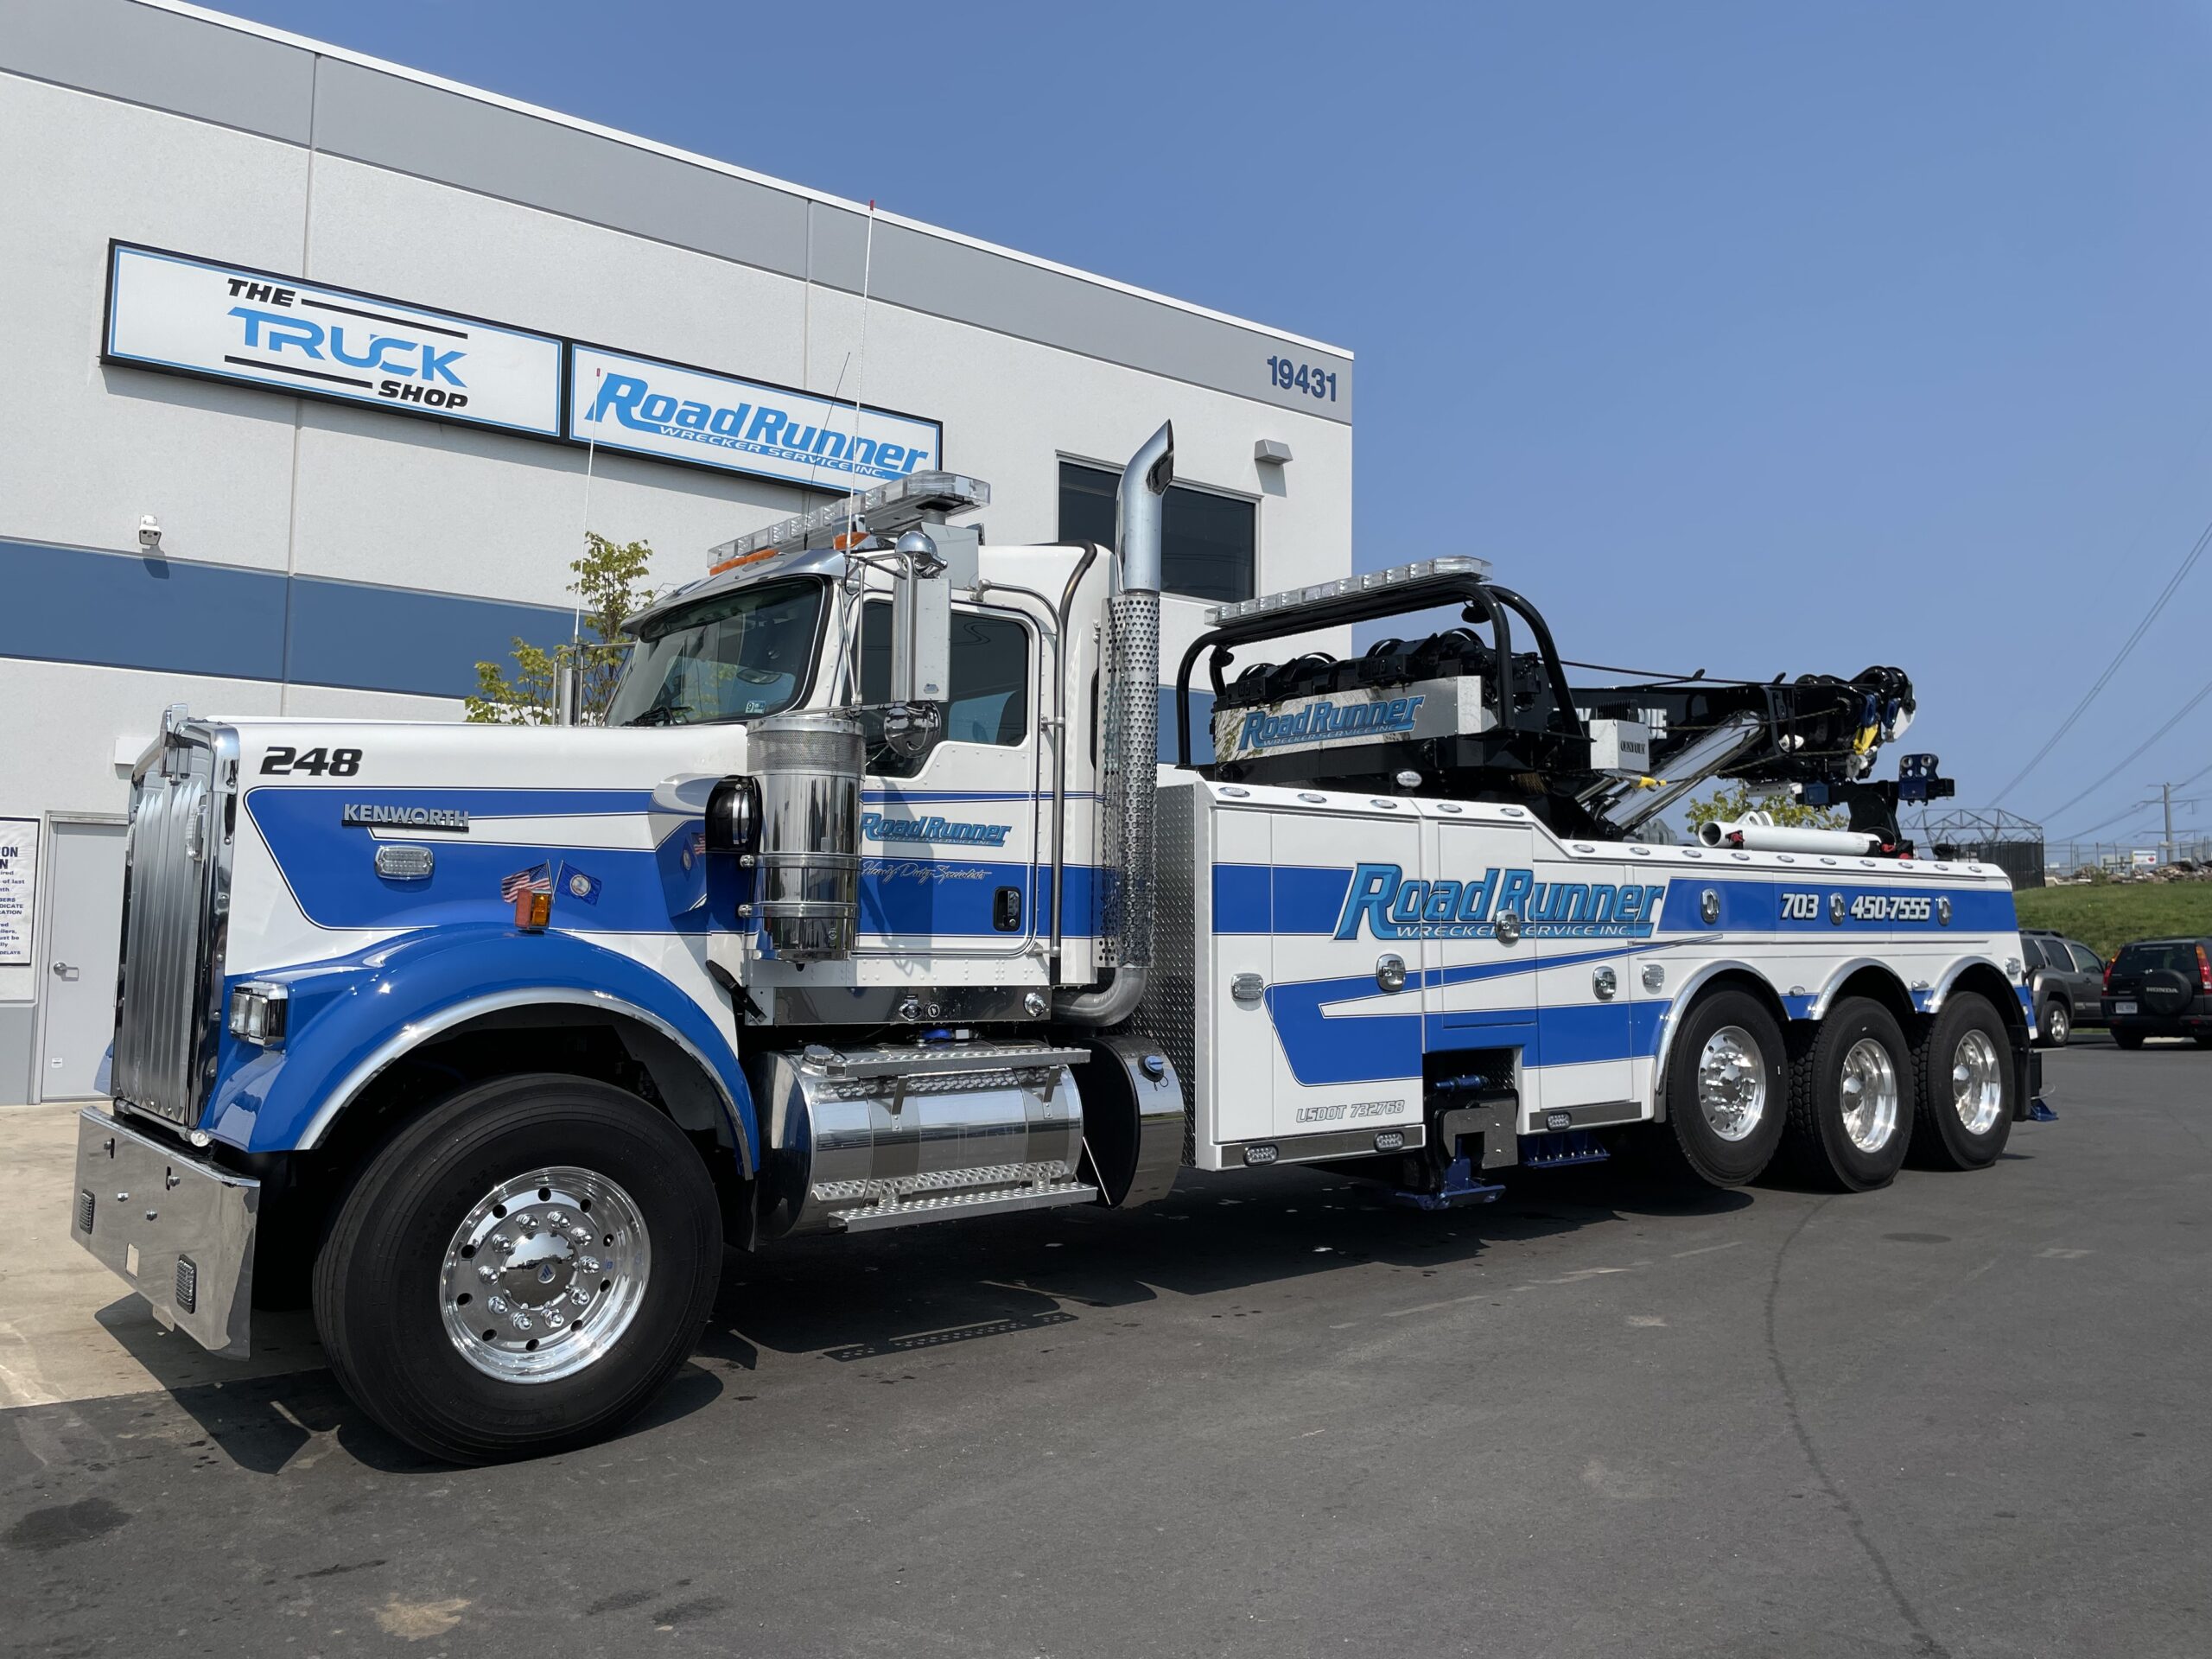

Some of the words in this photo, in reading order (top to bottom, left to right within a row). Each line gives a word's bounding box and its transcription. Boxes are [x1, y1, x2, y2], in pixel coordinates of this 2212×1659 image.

[227, 278, 296, 308] THE
[227, 307, 467, 388] TRUCK
[1267, 356, 1336, 402] 19431
[378, 380, 468, 409] SHOP
[659, 425, 760, 453] WRECKER
[767, 448, 850, 472] SERVICE
[855, 465, 886, 479] INC.
[1263, 734, 1315, 747] WRECKER
[1319, 727, 1373, 741] SERVICE
[259, 747, 363, 777] 248
[344, 804, 469, 827] KENWORTH
[1781, 893, 1819, 919] 703
[1850, 896, 1931, 921] 450-7555
[1396, 925, 1497, 937] WRECKE
[1599, 925, 1630, 936] INC.
[1296, 1105, 1347, 1122] USDOT
[1351, 1099, 1405, 1118] 732768
